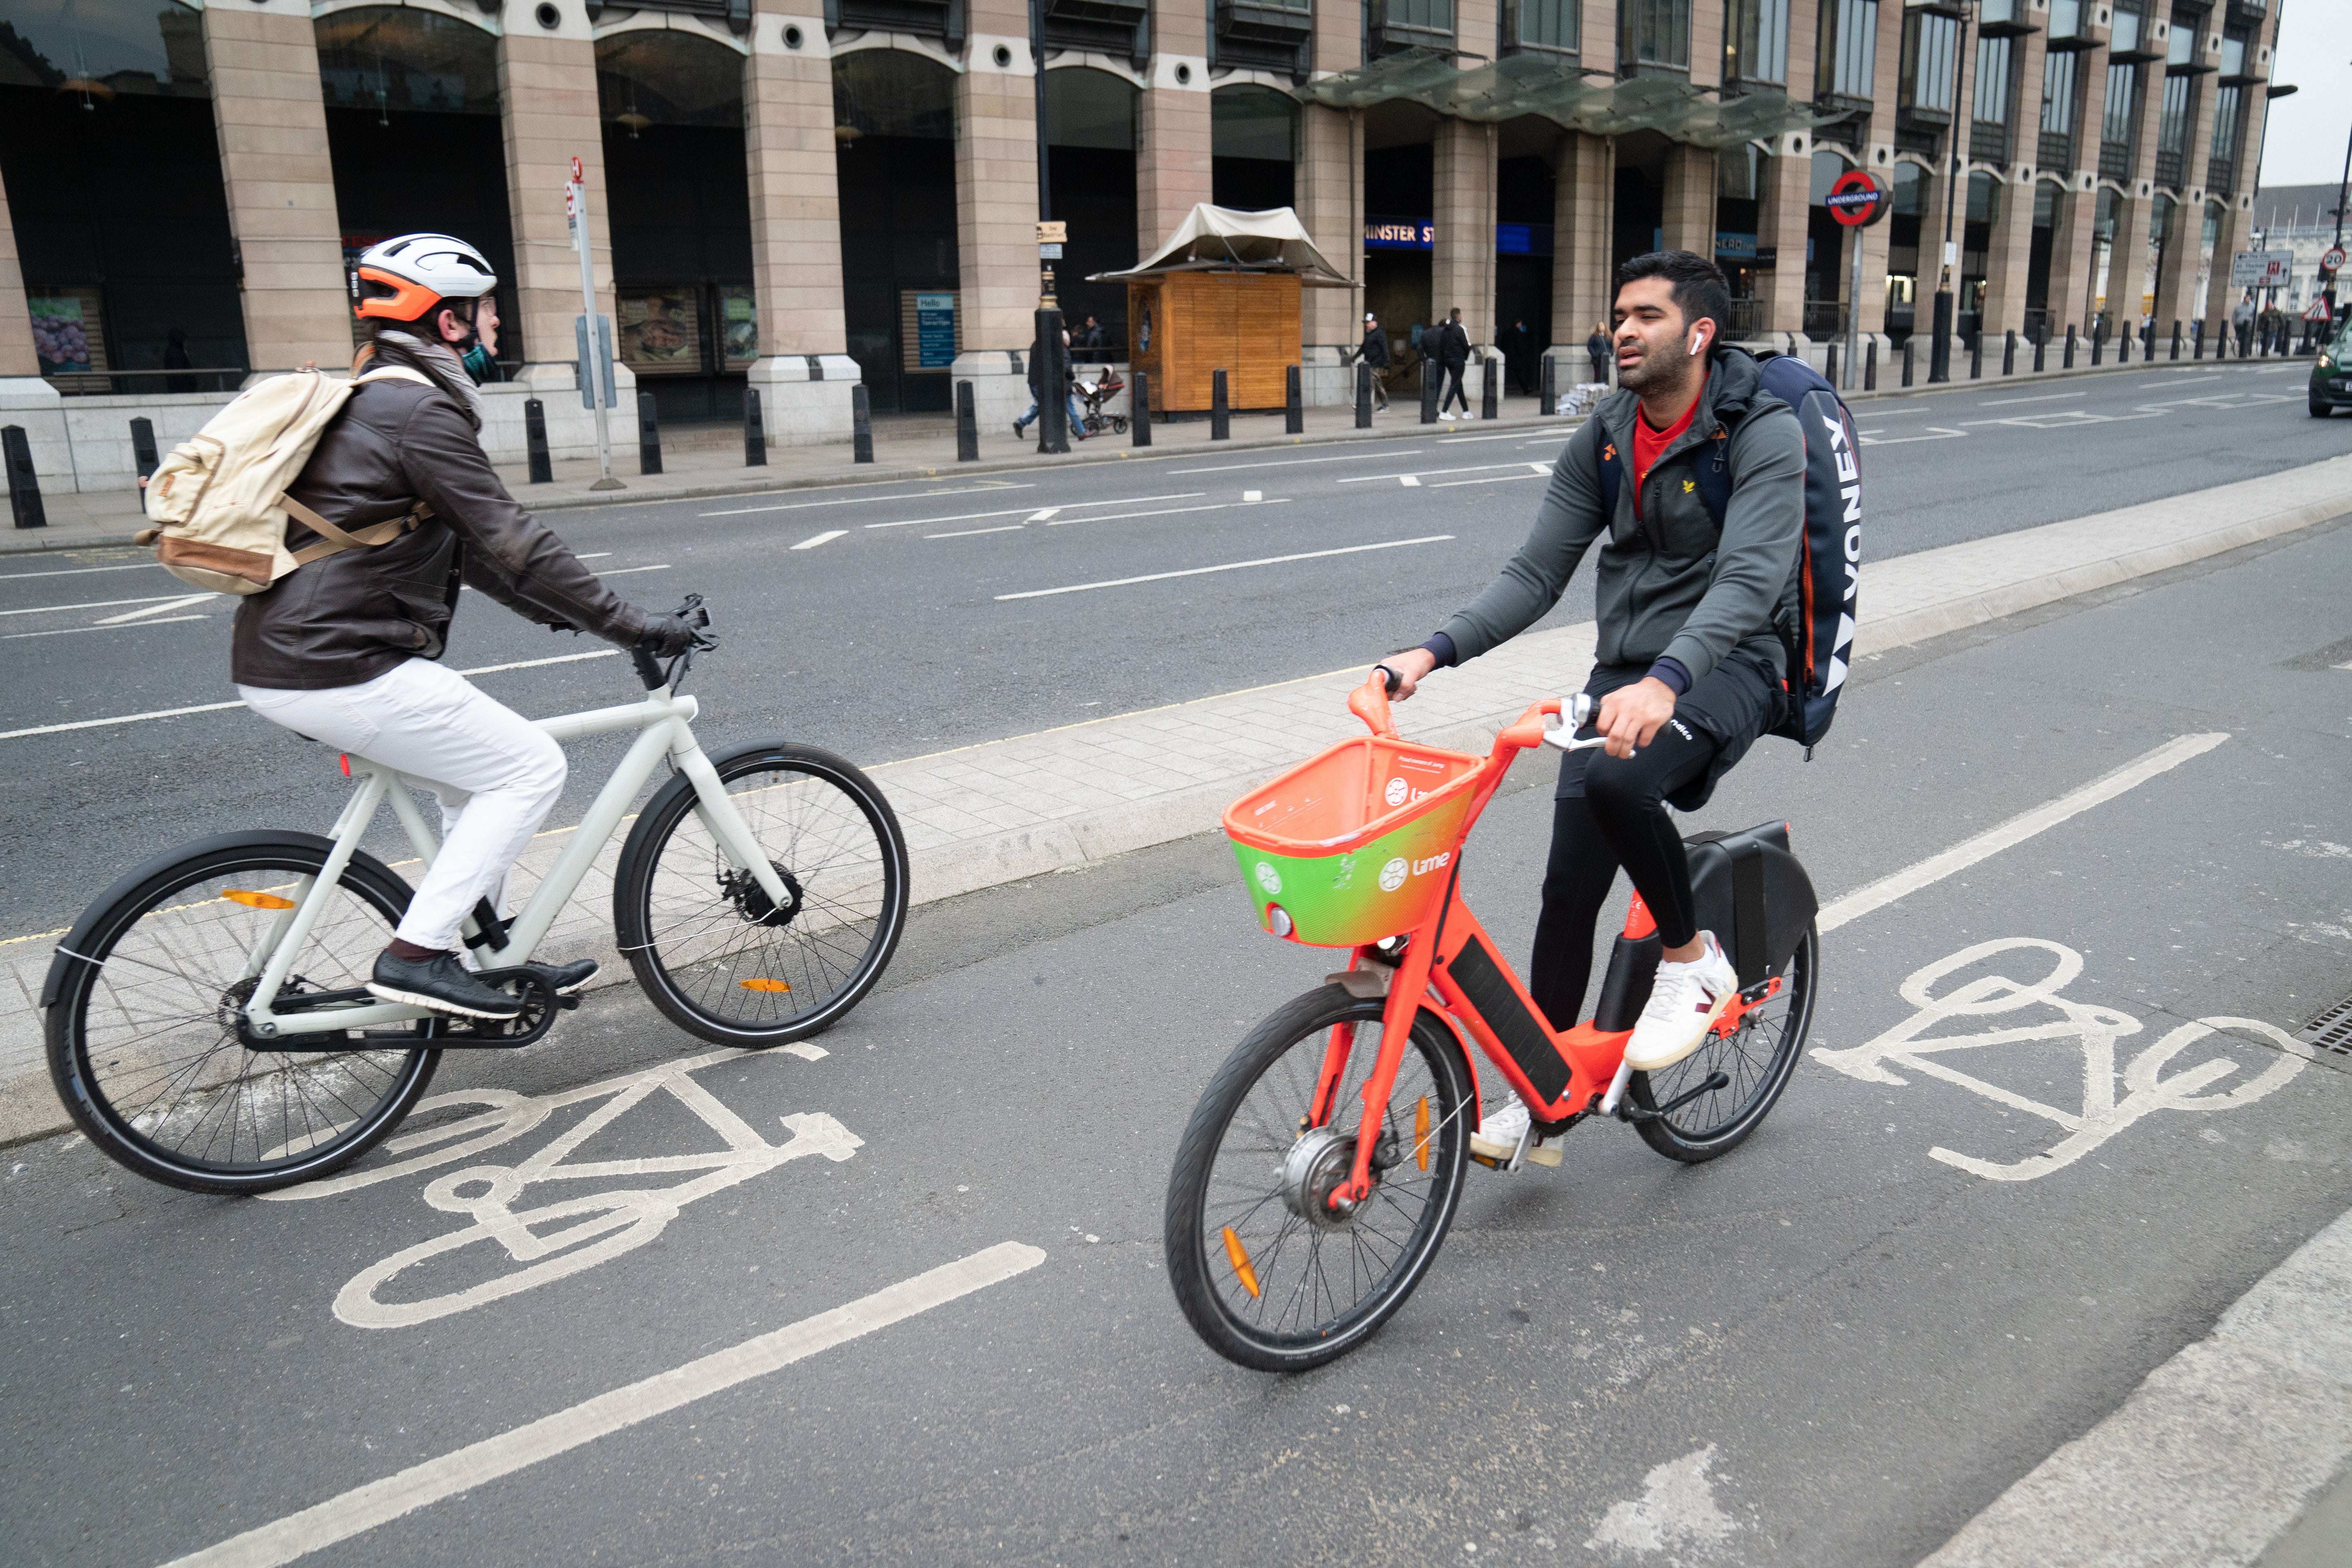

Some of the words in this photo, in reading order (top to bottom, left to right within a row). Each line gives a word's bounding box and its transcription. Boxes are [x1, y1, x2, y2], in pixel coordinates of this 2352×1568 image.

[572, 159, 580, 177] H
[1828, 192, 1879, 205] UNDERGROUND
[2326, 254, 2342, 265] 20
[921, 299, 940, 307] Hello
[1822, 415, 1861, 601] YONEX
[1413, 852, 1451, 876] Lime
